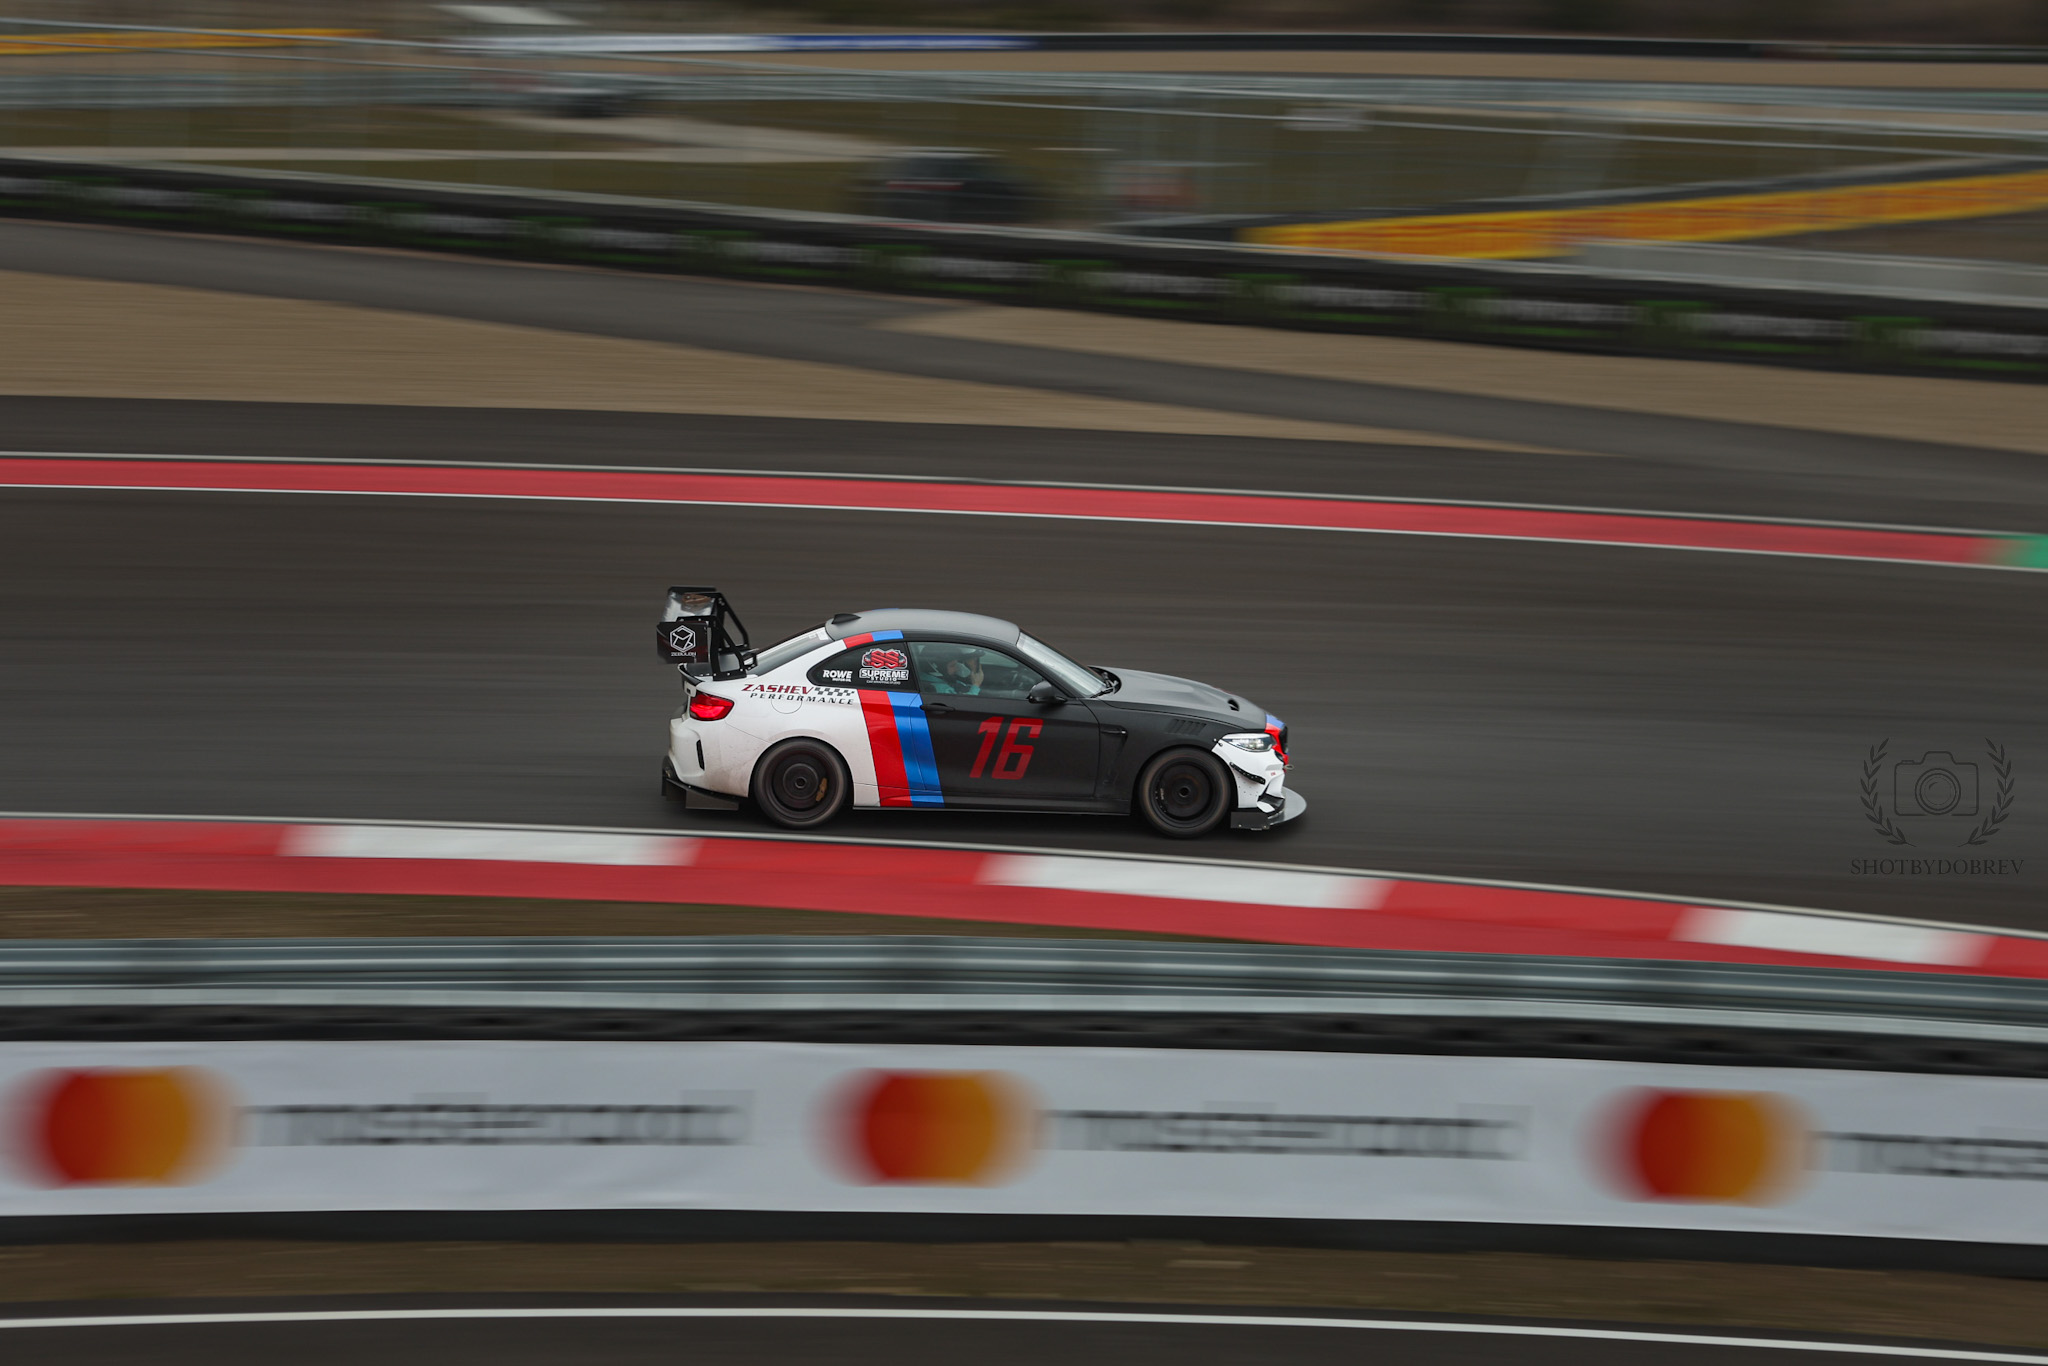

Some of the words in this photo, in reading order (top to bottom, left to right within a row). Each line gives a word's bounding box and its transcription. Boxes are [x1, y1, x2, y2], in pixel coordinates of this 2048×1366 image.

[823, 670, 853, 679] ROWE
[861, 670, 907, 679] SUPREME
[741, 684, 814, 695] ZASHEV
[749, 692, 854, 706] PERFORMANCE
[969, 716, 1044, 780] 16
